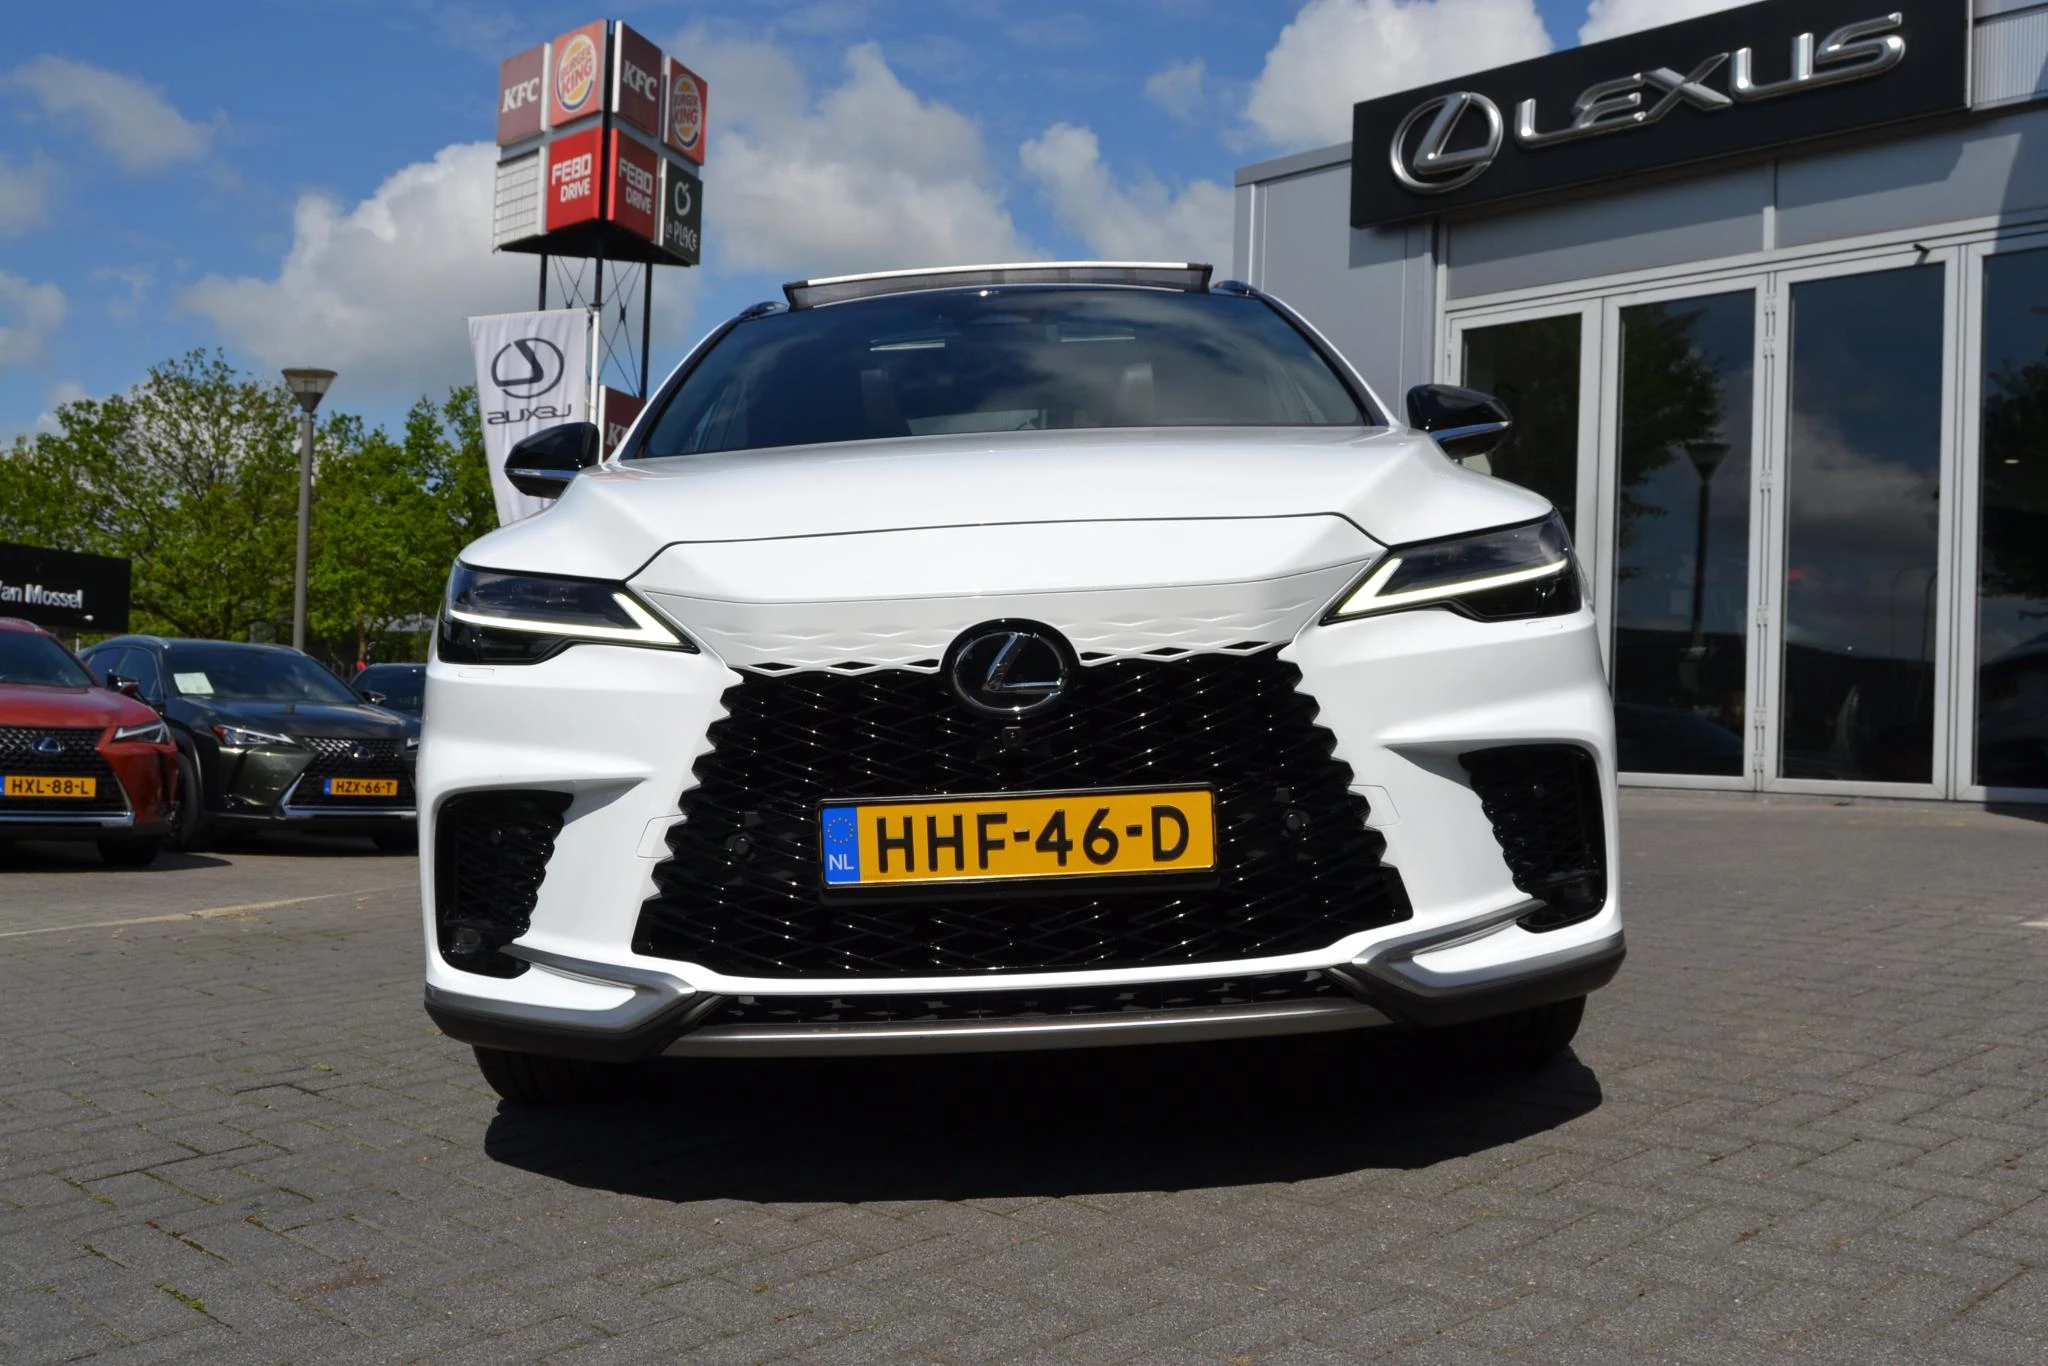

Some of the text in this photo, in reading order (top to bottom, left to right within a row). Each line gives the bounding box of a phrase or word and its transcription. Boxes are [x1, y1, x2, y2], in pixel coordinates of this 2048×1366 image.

[502, 77, 540, 113] KFC
[561, 62, 592, 98] KING
[623, 60, 657, 101] KFC
[1514, 11, 1907, 150] LEXUS
[552, 153, 592, 186] FEBO
[619, 157, 653, 196] FEBO
[560, 178, 591, 203] DRIVE
[625, 186, 652, 215] DRIVE
[674, 221, 698, 252] PLACE
[0, 580, 83, 609] an Mossel
[12, 778, 89, 795] HXL-88-L
[336, 781, 393, 794] HZX-66-T
[828, 805, 1189, 873] NL HHF-46-D
